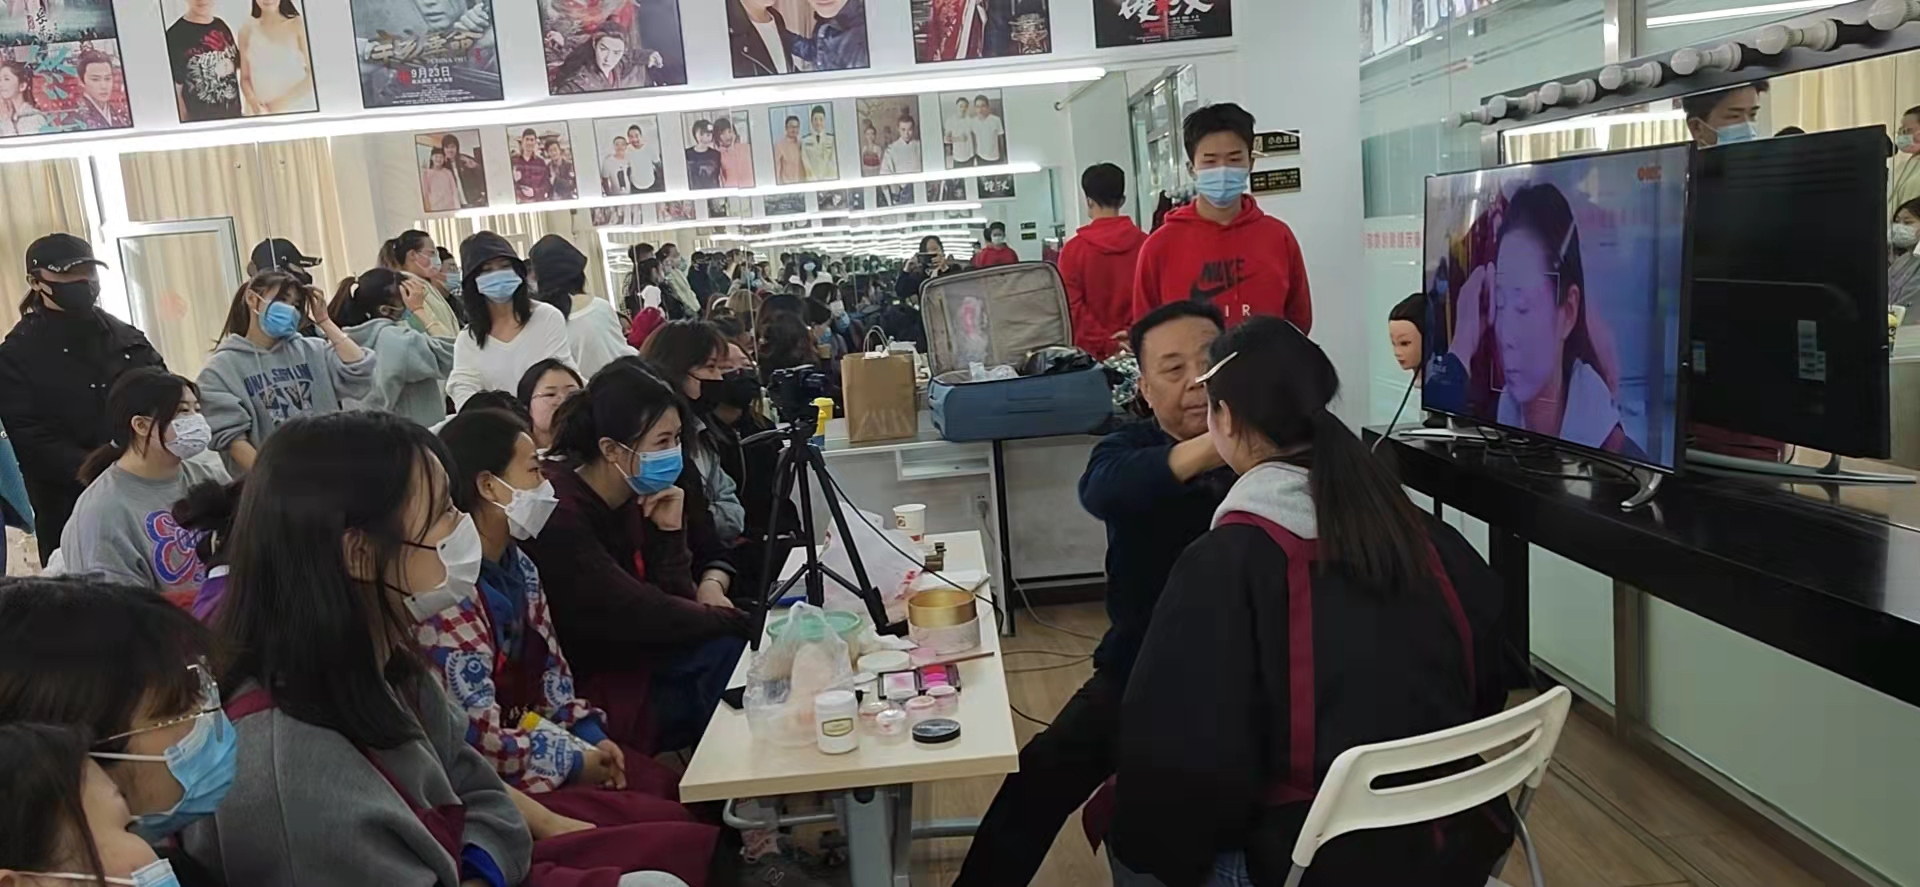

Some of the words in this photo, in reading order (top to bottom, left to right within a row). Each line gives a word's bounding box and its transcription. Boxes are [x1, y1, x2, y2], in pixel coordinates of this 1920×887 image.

[411, 66, 451, 79] 9月23日
[1200, 258, 1246, 286] NIKE
[1224, 304, 1252, 317] IR
